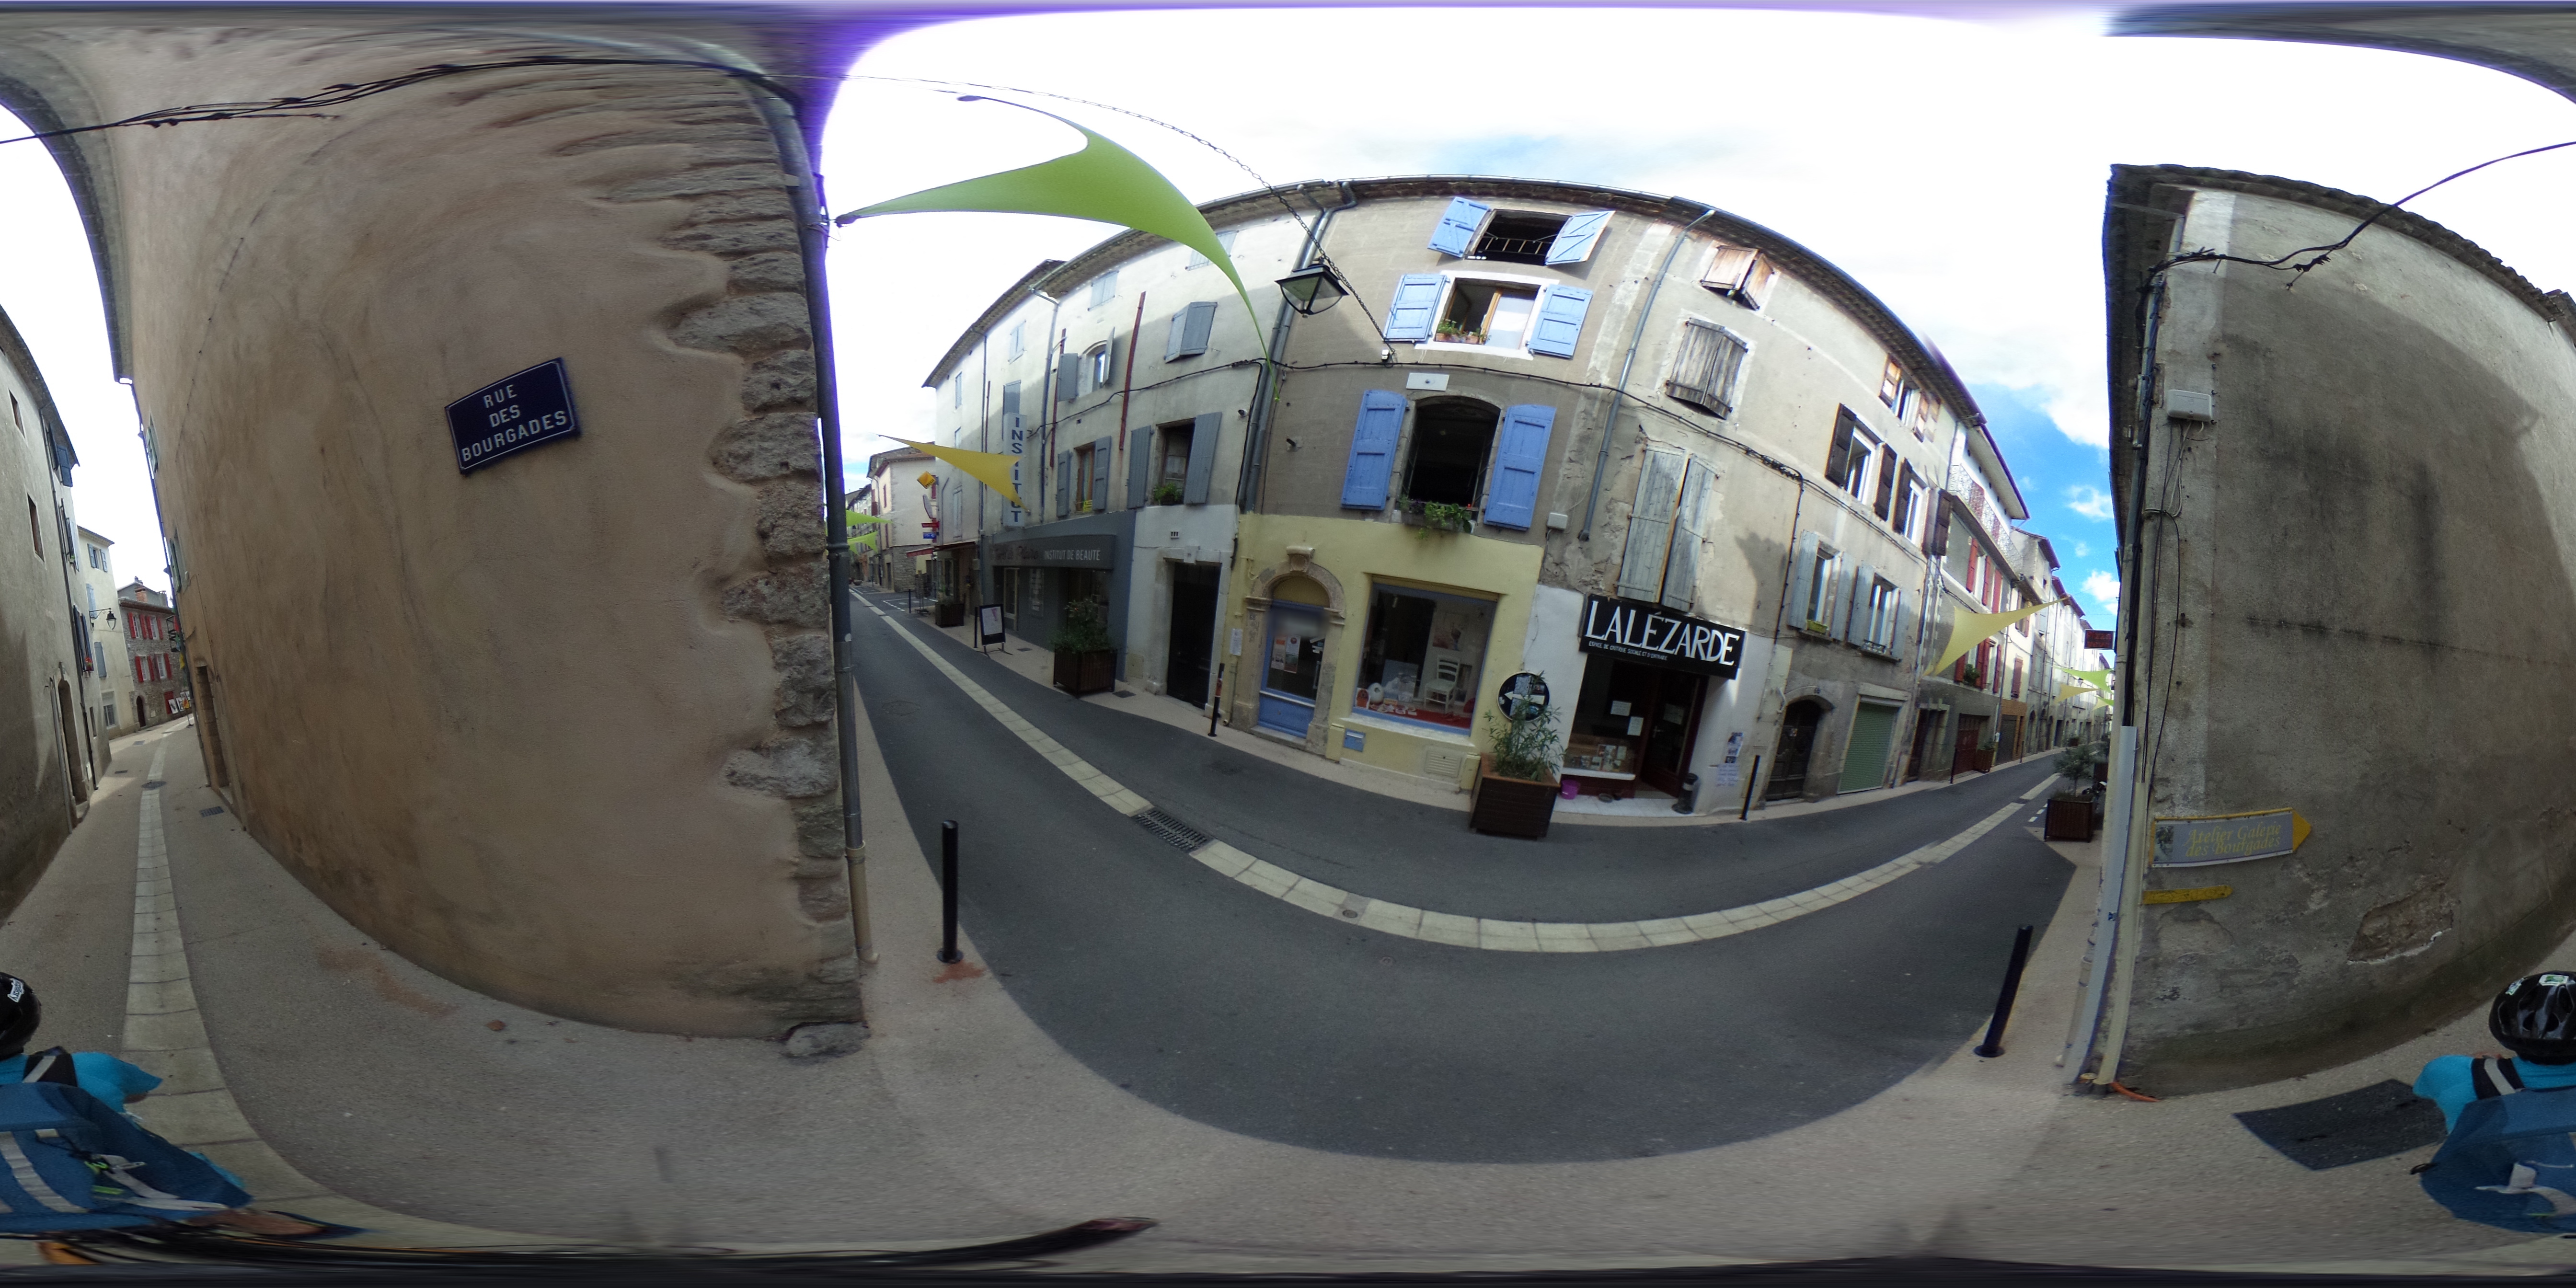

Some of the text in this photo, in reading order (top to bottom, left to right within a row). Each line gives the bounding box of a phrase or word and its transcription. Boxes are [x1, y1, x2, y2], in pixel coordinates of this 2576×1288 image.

[483, 384, 517, 408] RUE
[489, 404, 521, 427] DES
[461, 410, 567, 462] BOURGADES
[1044, 550, 1066, 560] INSTITUT
[1067, 550, 1074, 560] DE
[2184, 821, 2281, 846] Atelier Galerie
[2185, 837, 2280, 857] des Bourgades
